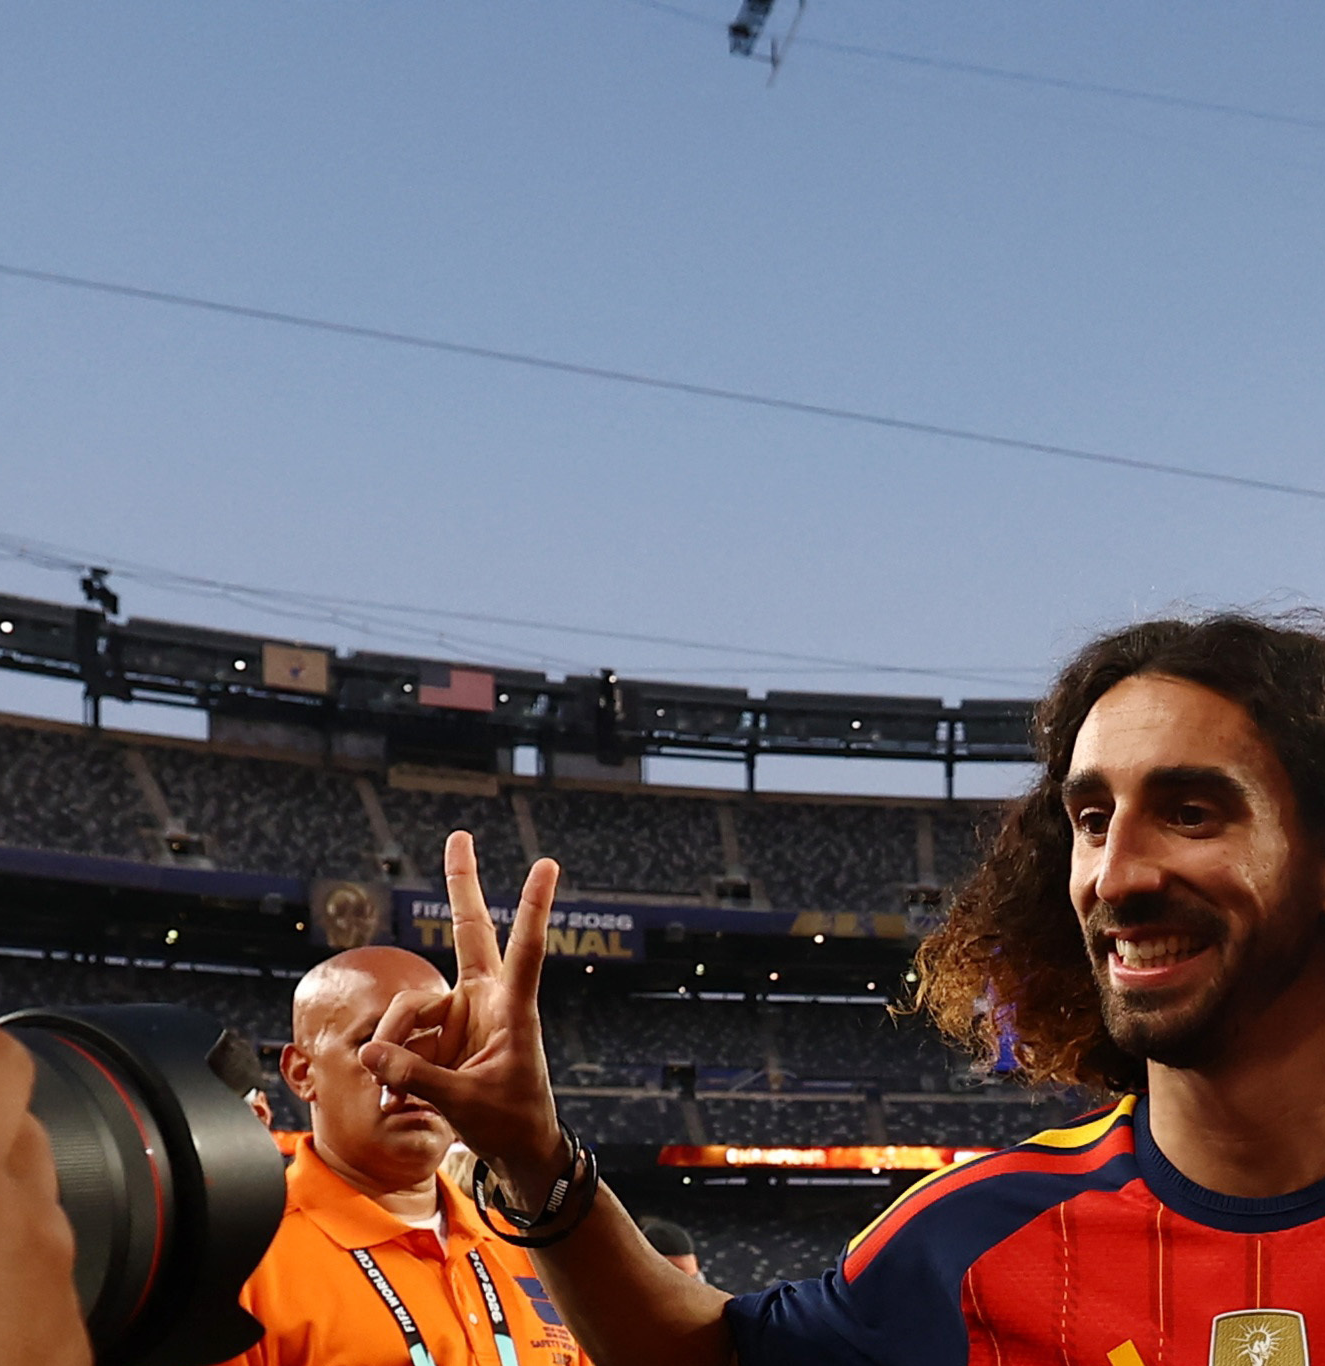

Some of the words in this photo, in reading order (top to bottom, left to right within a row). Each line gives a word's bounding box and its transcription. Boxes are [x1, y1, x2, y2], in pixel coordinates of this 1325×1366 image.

[412, 901, 452, 919] FIFA
[568, 912, 633, 931] 2026
[547, 928, 633, 958] NAL
[546, 1178, 569, 1213] PUMA
[367, 1268, 399, 1308] WORLD
[474, 1261, 489, 1283] CUP
[482, 1282, 503, 1324] 2026
[394, 1305, 416, 1333] FIFA
